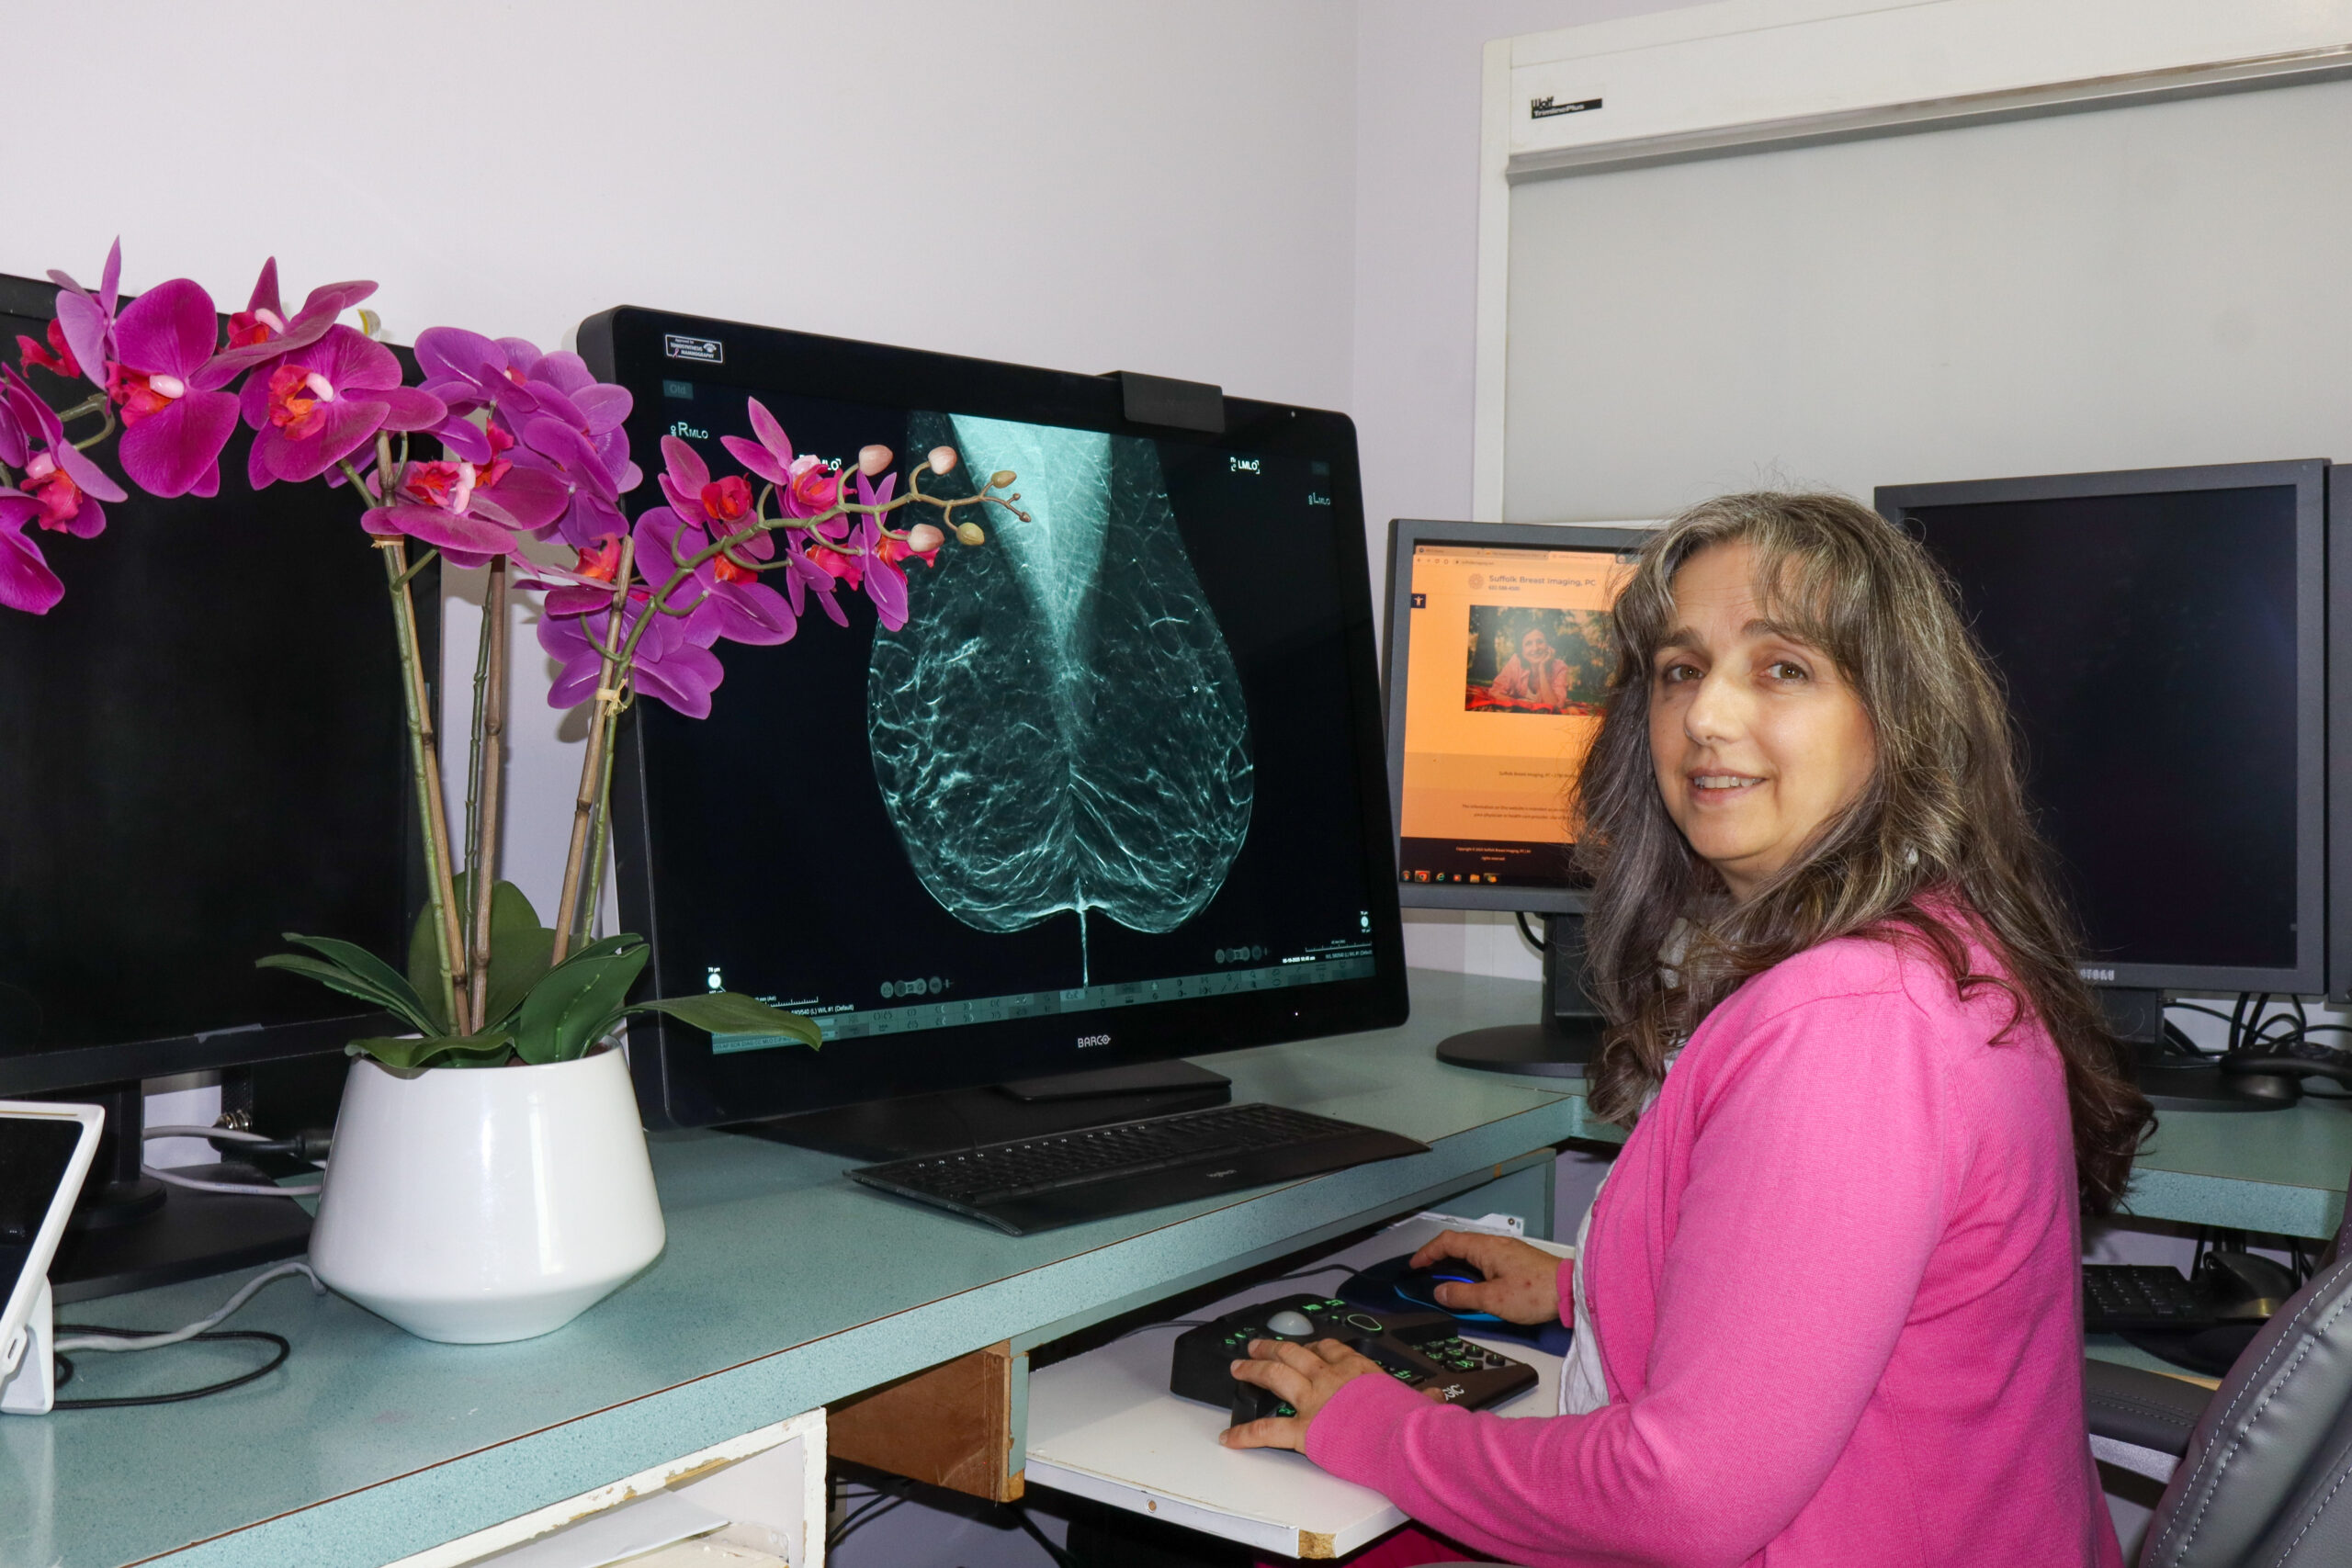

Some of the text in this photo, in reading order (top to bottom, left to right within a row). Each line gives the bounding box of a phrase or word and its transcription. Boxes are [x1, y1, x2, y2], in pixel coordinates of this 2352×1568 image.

[1488, 575, 1517, 583] Suffolk
[1520, 576, 1544, 584] Breast
[1547, 577, 1582, 587] Imaging,
[1077, 1034, 1112, 1048] BARCO
